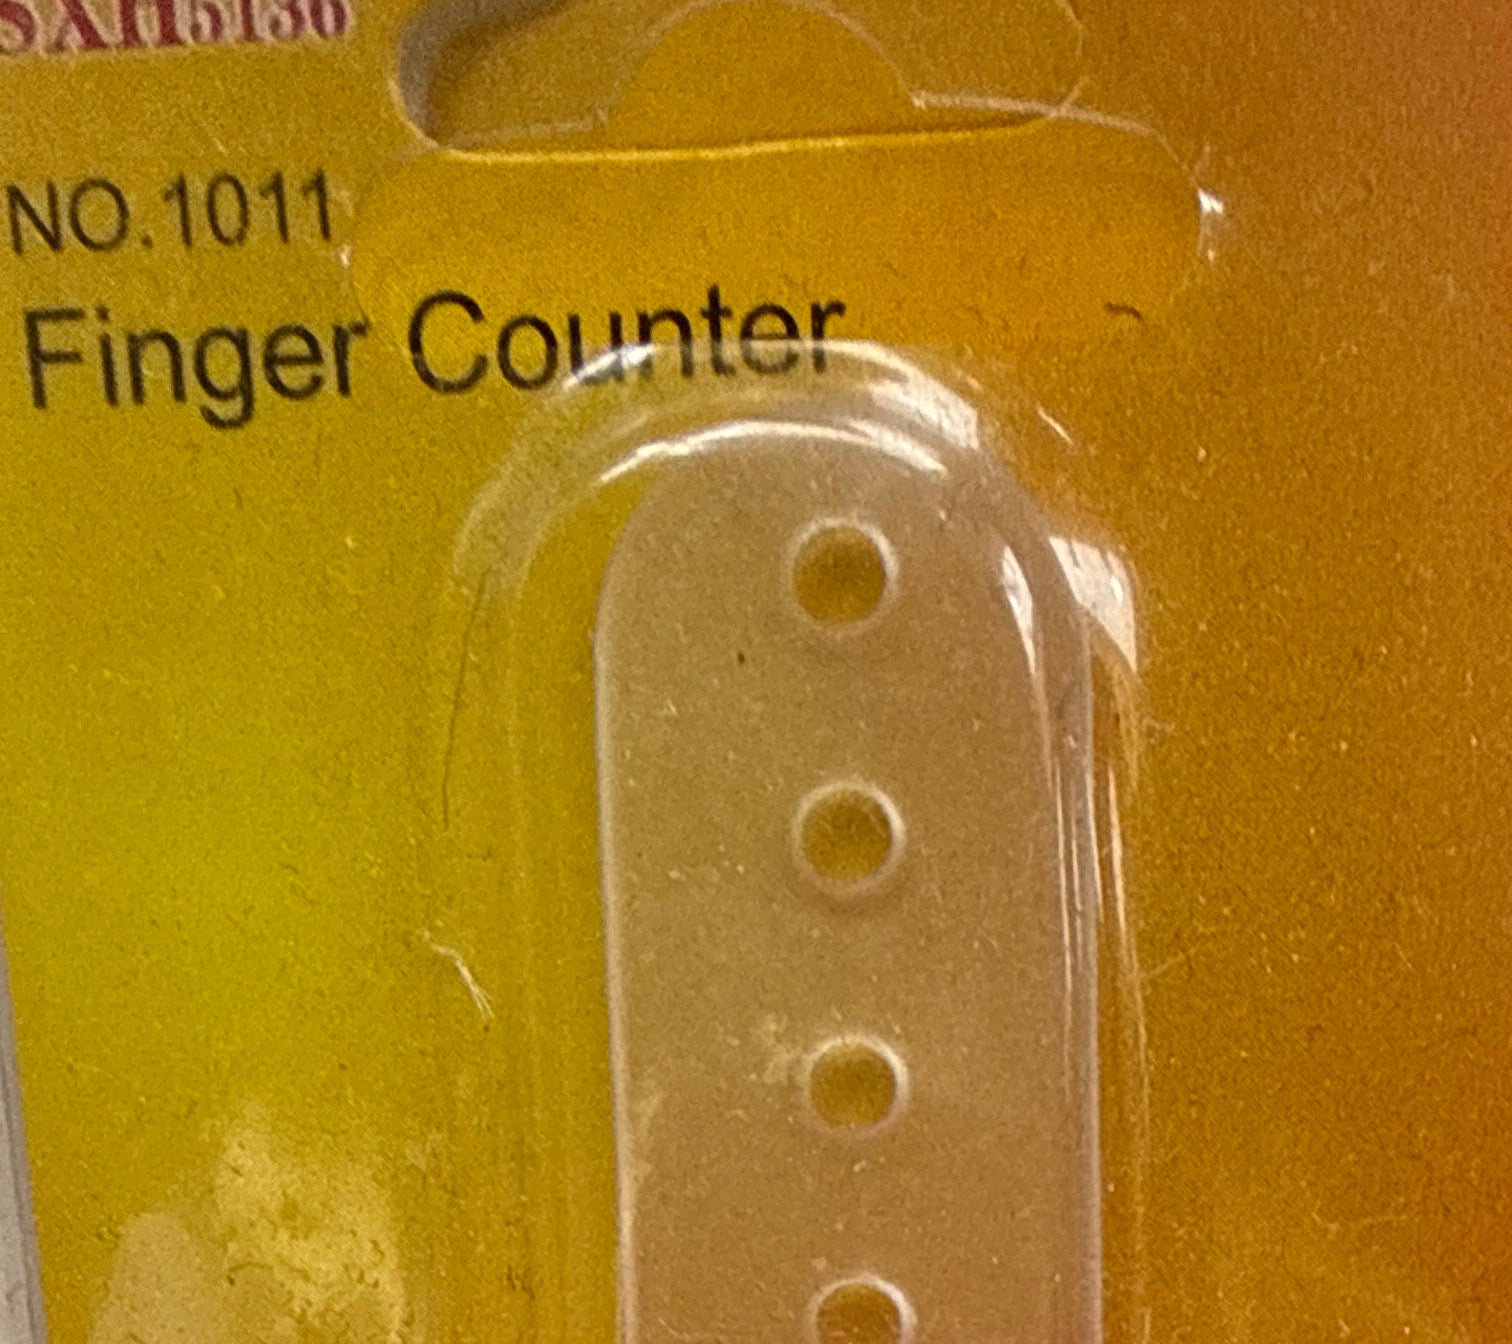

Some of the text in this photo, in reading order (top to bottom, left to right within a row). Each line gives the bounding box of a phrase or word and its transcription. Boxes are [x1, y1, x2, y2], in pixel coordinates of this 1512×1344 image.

[3, 168, 334, 256] NO.1011
[22, 283, 847, 430] Finger Counter
